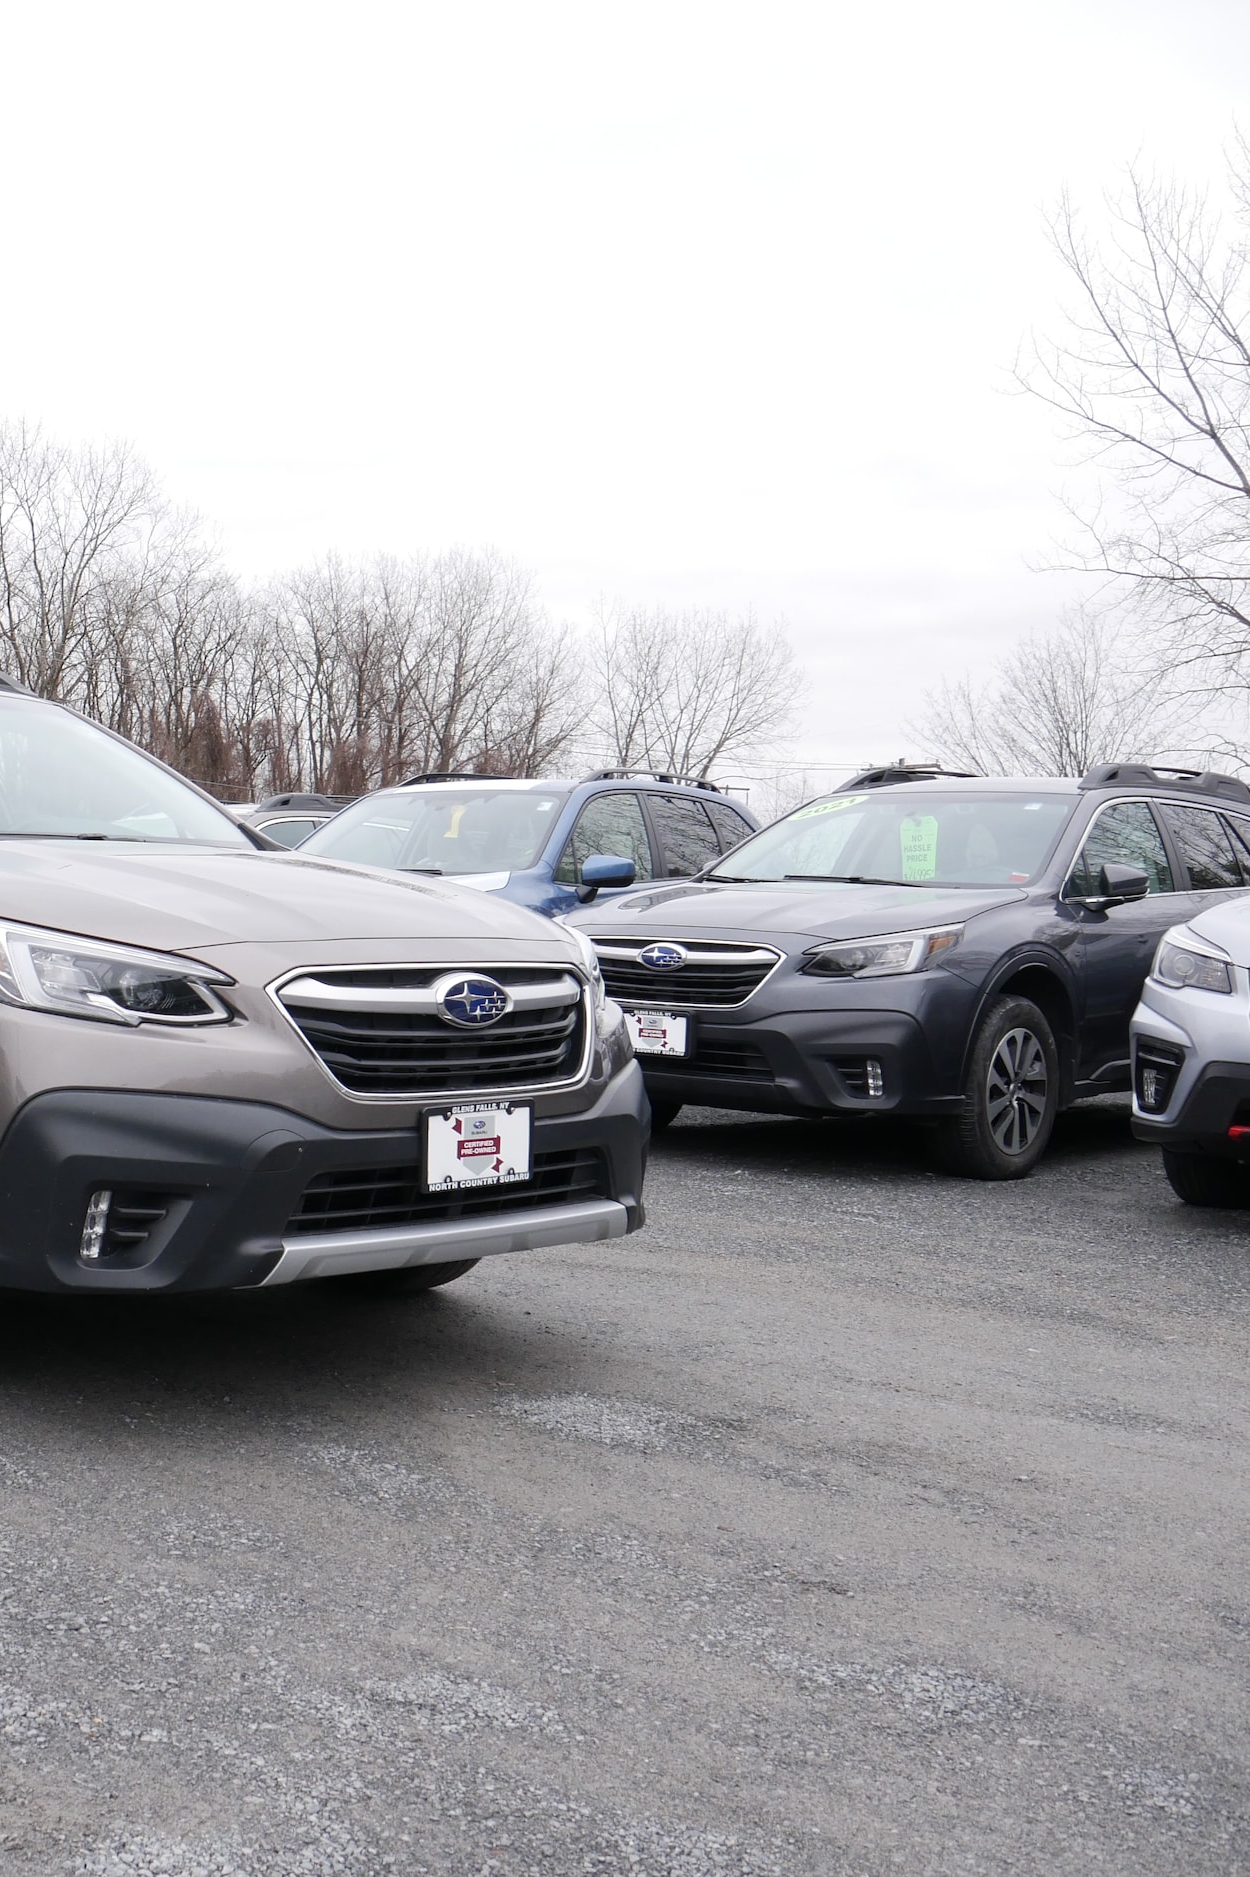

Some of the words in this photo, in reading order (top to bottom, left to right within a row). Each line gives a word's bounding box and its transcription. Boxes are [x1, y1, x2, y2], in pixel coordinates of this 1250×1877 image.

[797, 797, 857, 819] 2021
[911, 834, 923, 842] NO
[903, 844, 932, 852] HASSLE
[906, 854, 928, 863] PRICE
[452, 1105, 475, 1114] GLENS
[499, 1102, 510, 1110] NY
[463, 1140, 494, 1149] CERTIFIED
[461, 1147, 496, 1155] PRE-OWNED
[428, 1180, 458, 1192] NORTH
[460, 1178, 498, 1188] COUNTRY
[499, 1173, 530, 1184] SUBARU
